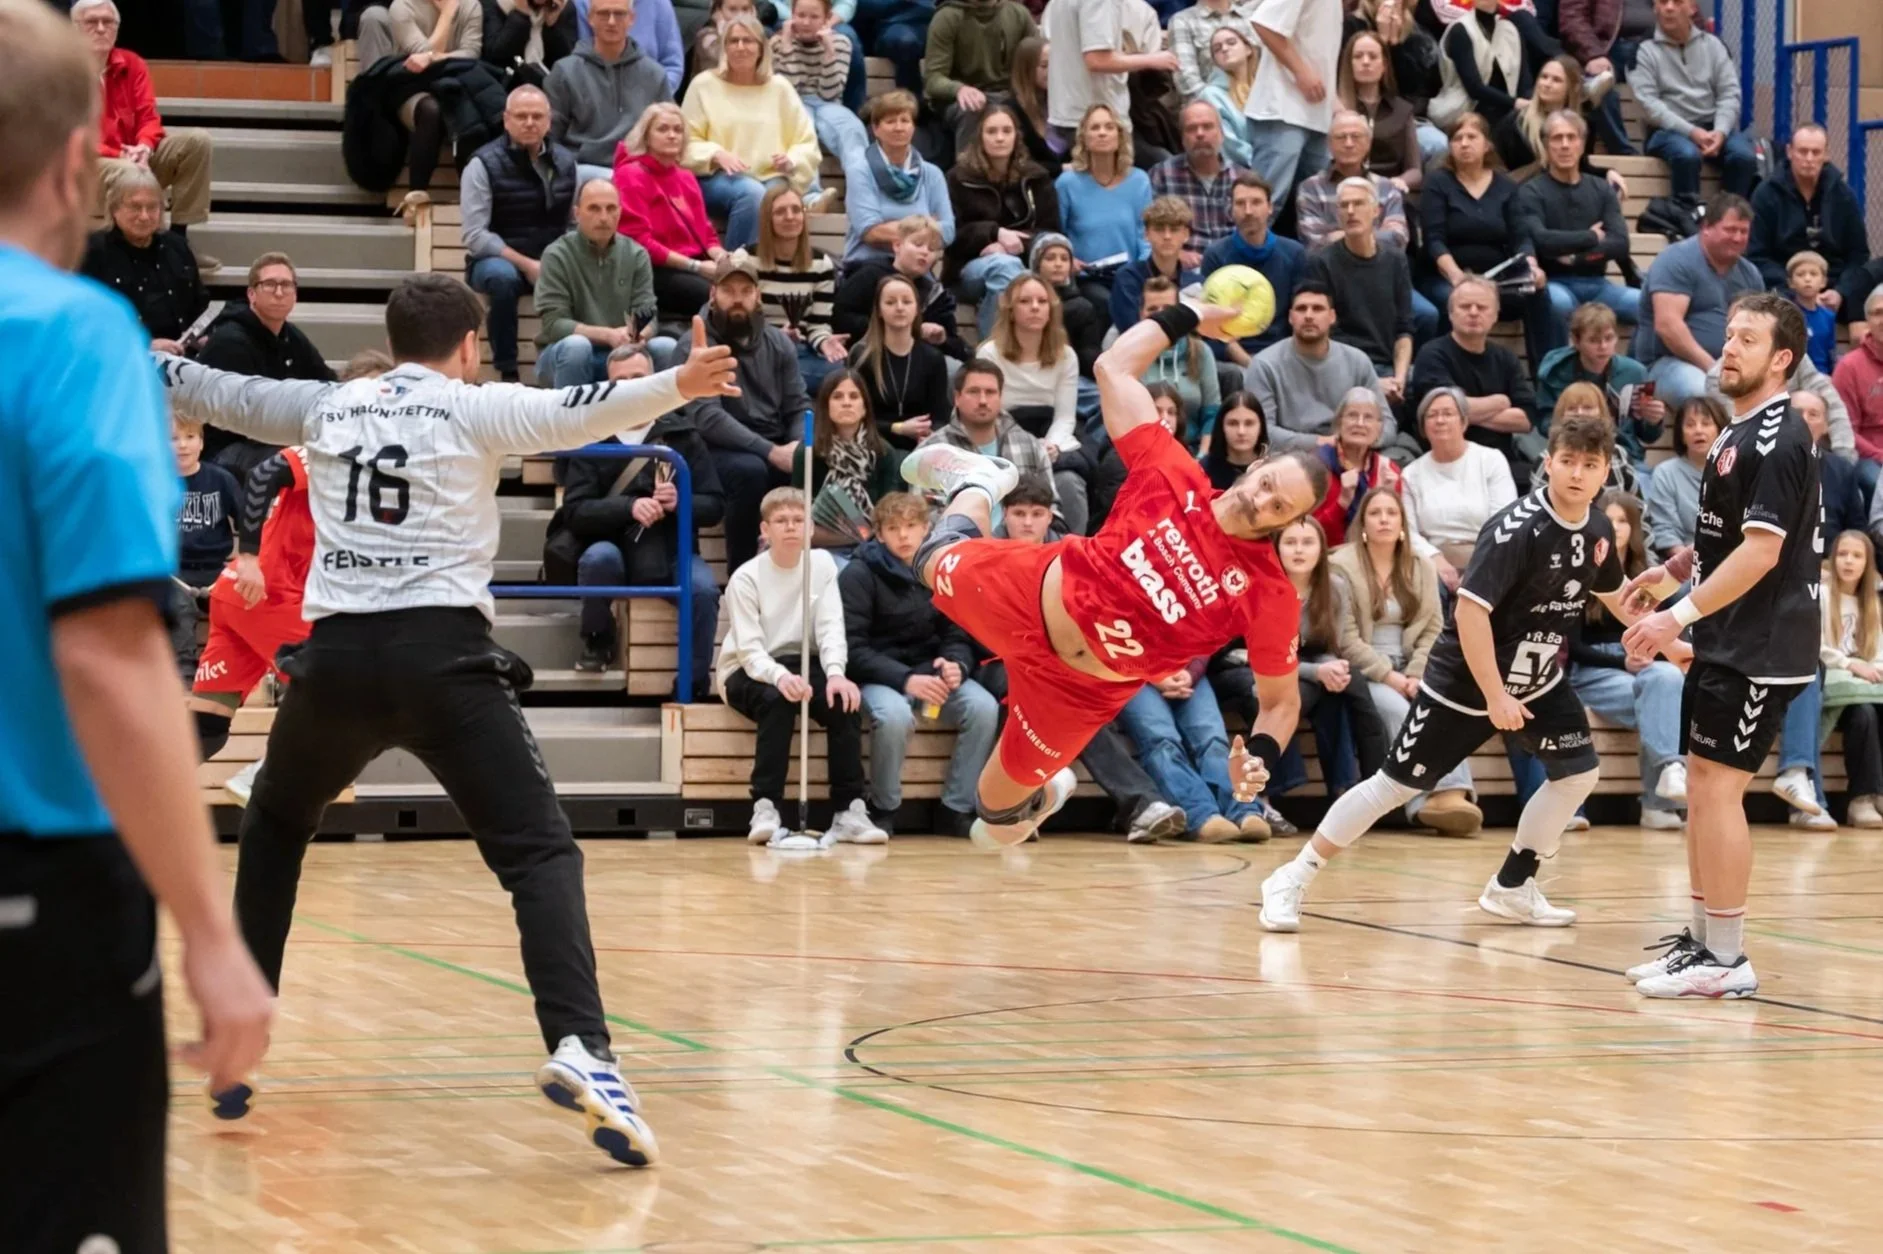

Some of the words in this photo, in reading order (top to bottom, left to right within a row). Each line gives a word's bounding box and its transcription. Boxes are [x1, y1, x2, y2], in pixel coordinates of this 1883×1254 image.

[338, 444, 410, 526] 16
[1120, 536, 1187, 625] brass
[1146, 528, 1157, 538] A
[1153, 536, 1175, 567] Bosch
[1173, 566, 1203, 610] Company
[1157, 517, 1220, 606] rexroth
[1571, 533, 1585, 568] 3
[1094, 619, 1144, 659] 22
[1026, 728, 1062, 758] ENERGIE
